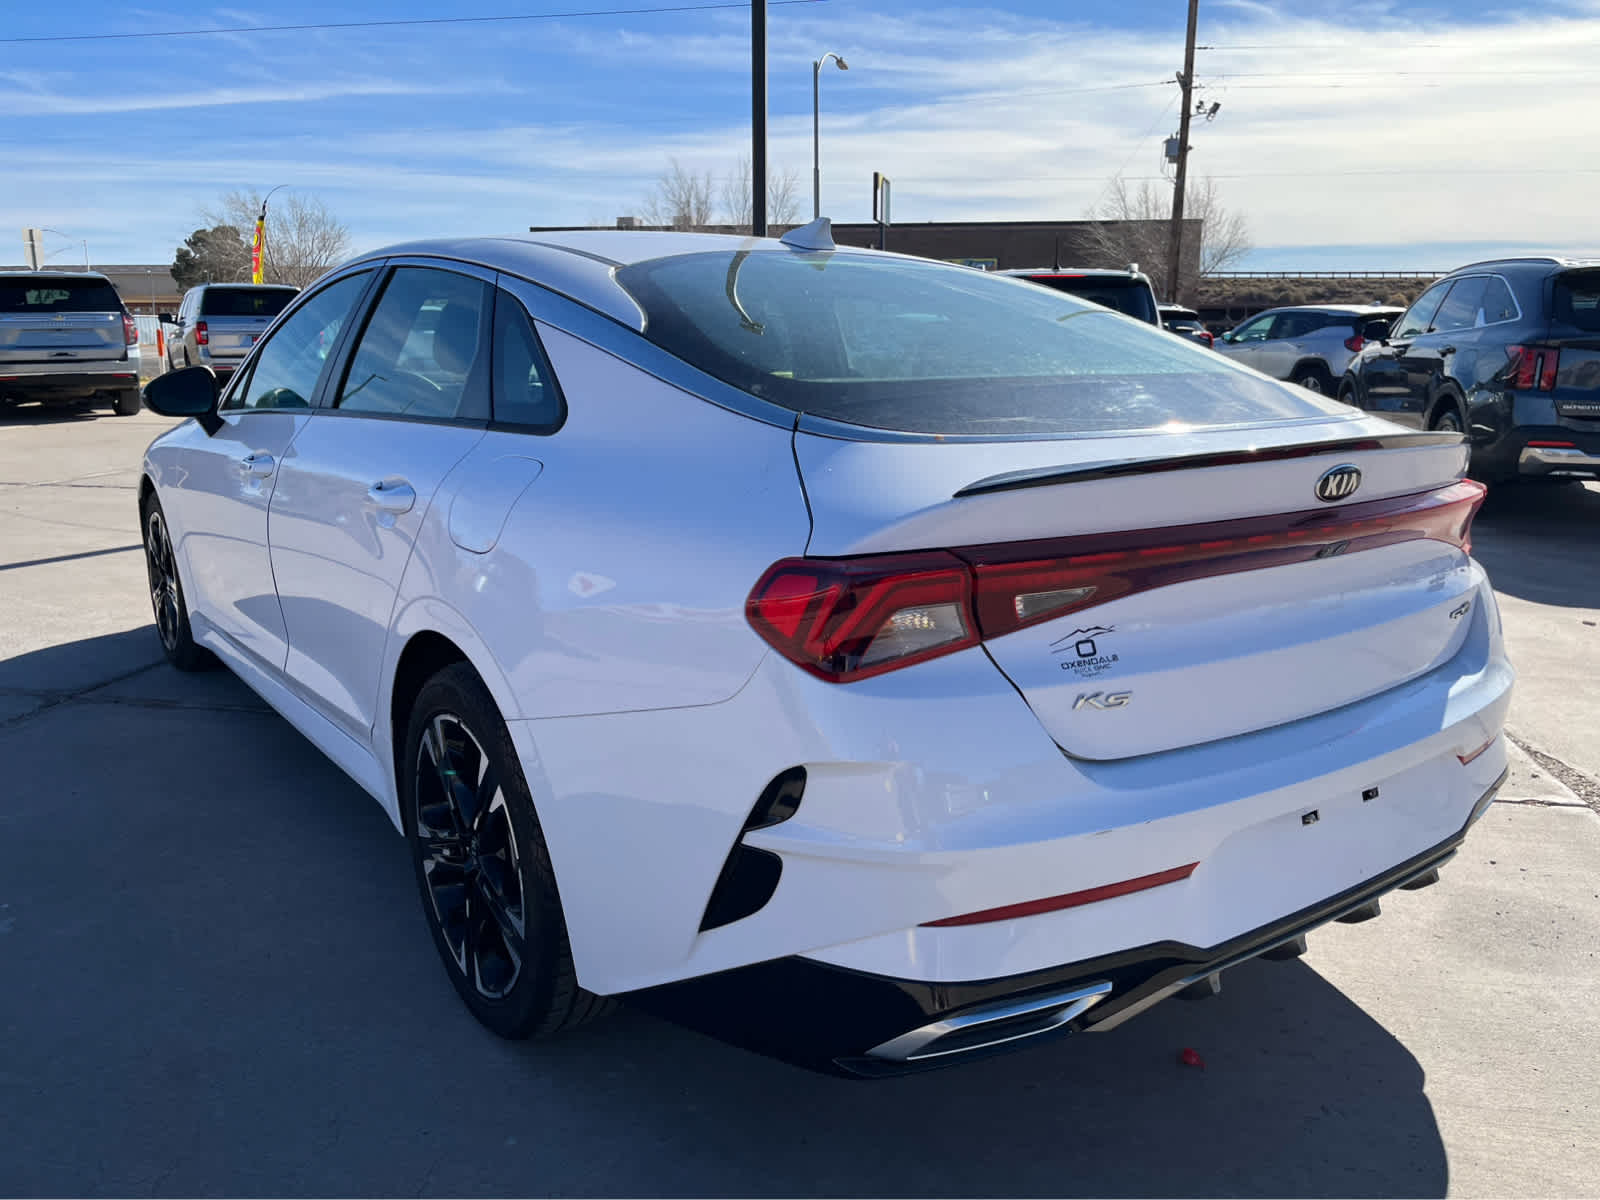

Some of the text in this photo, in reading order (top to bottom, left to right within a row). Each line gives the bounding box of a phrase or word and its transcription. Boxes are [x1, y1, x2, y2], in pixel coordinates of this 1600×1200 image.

[1324, 473, 1357, 496] KIA
[1061, 654, 1119, 670] OXENDALE
[1072, 690, 1133, 709] K5
